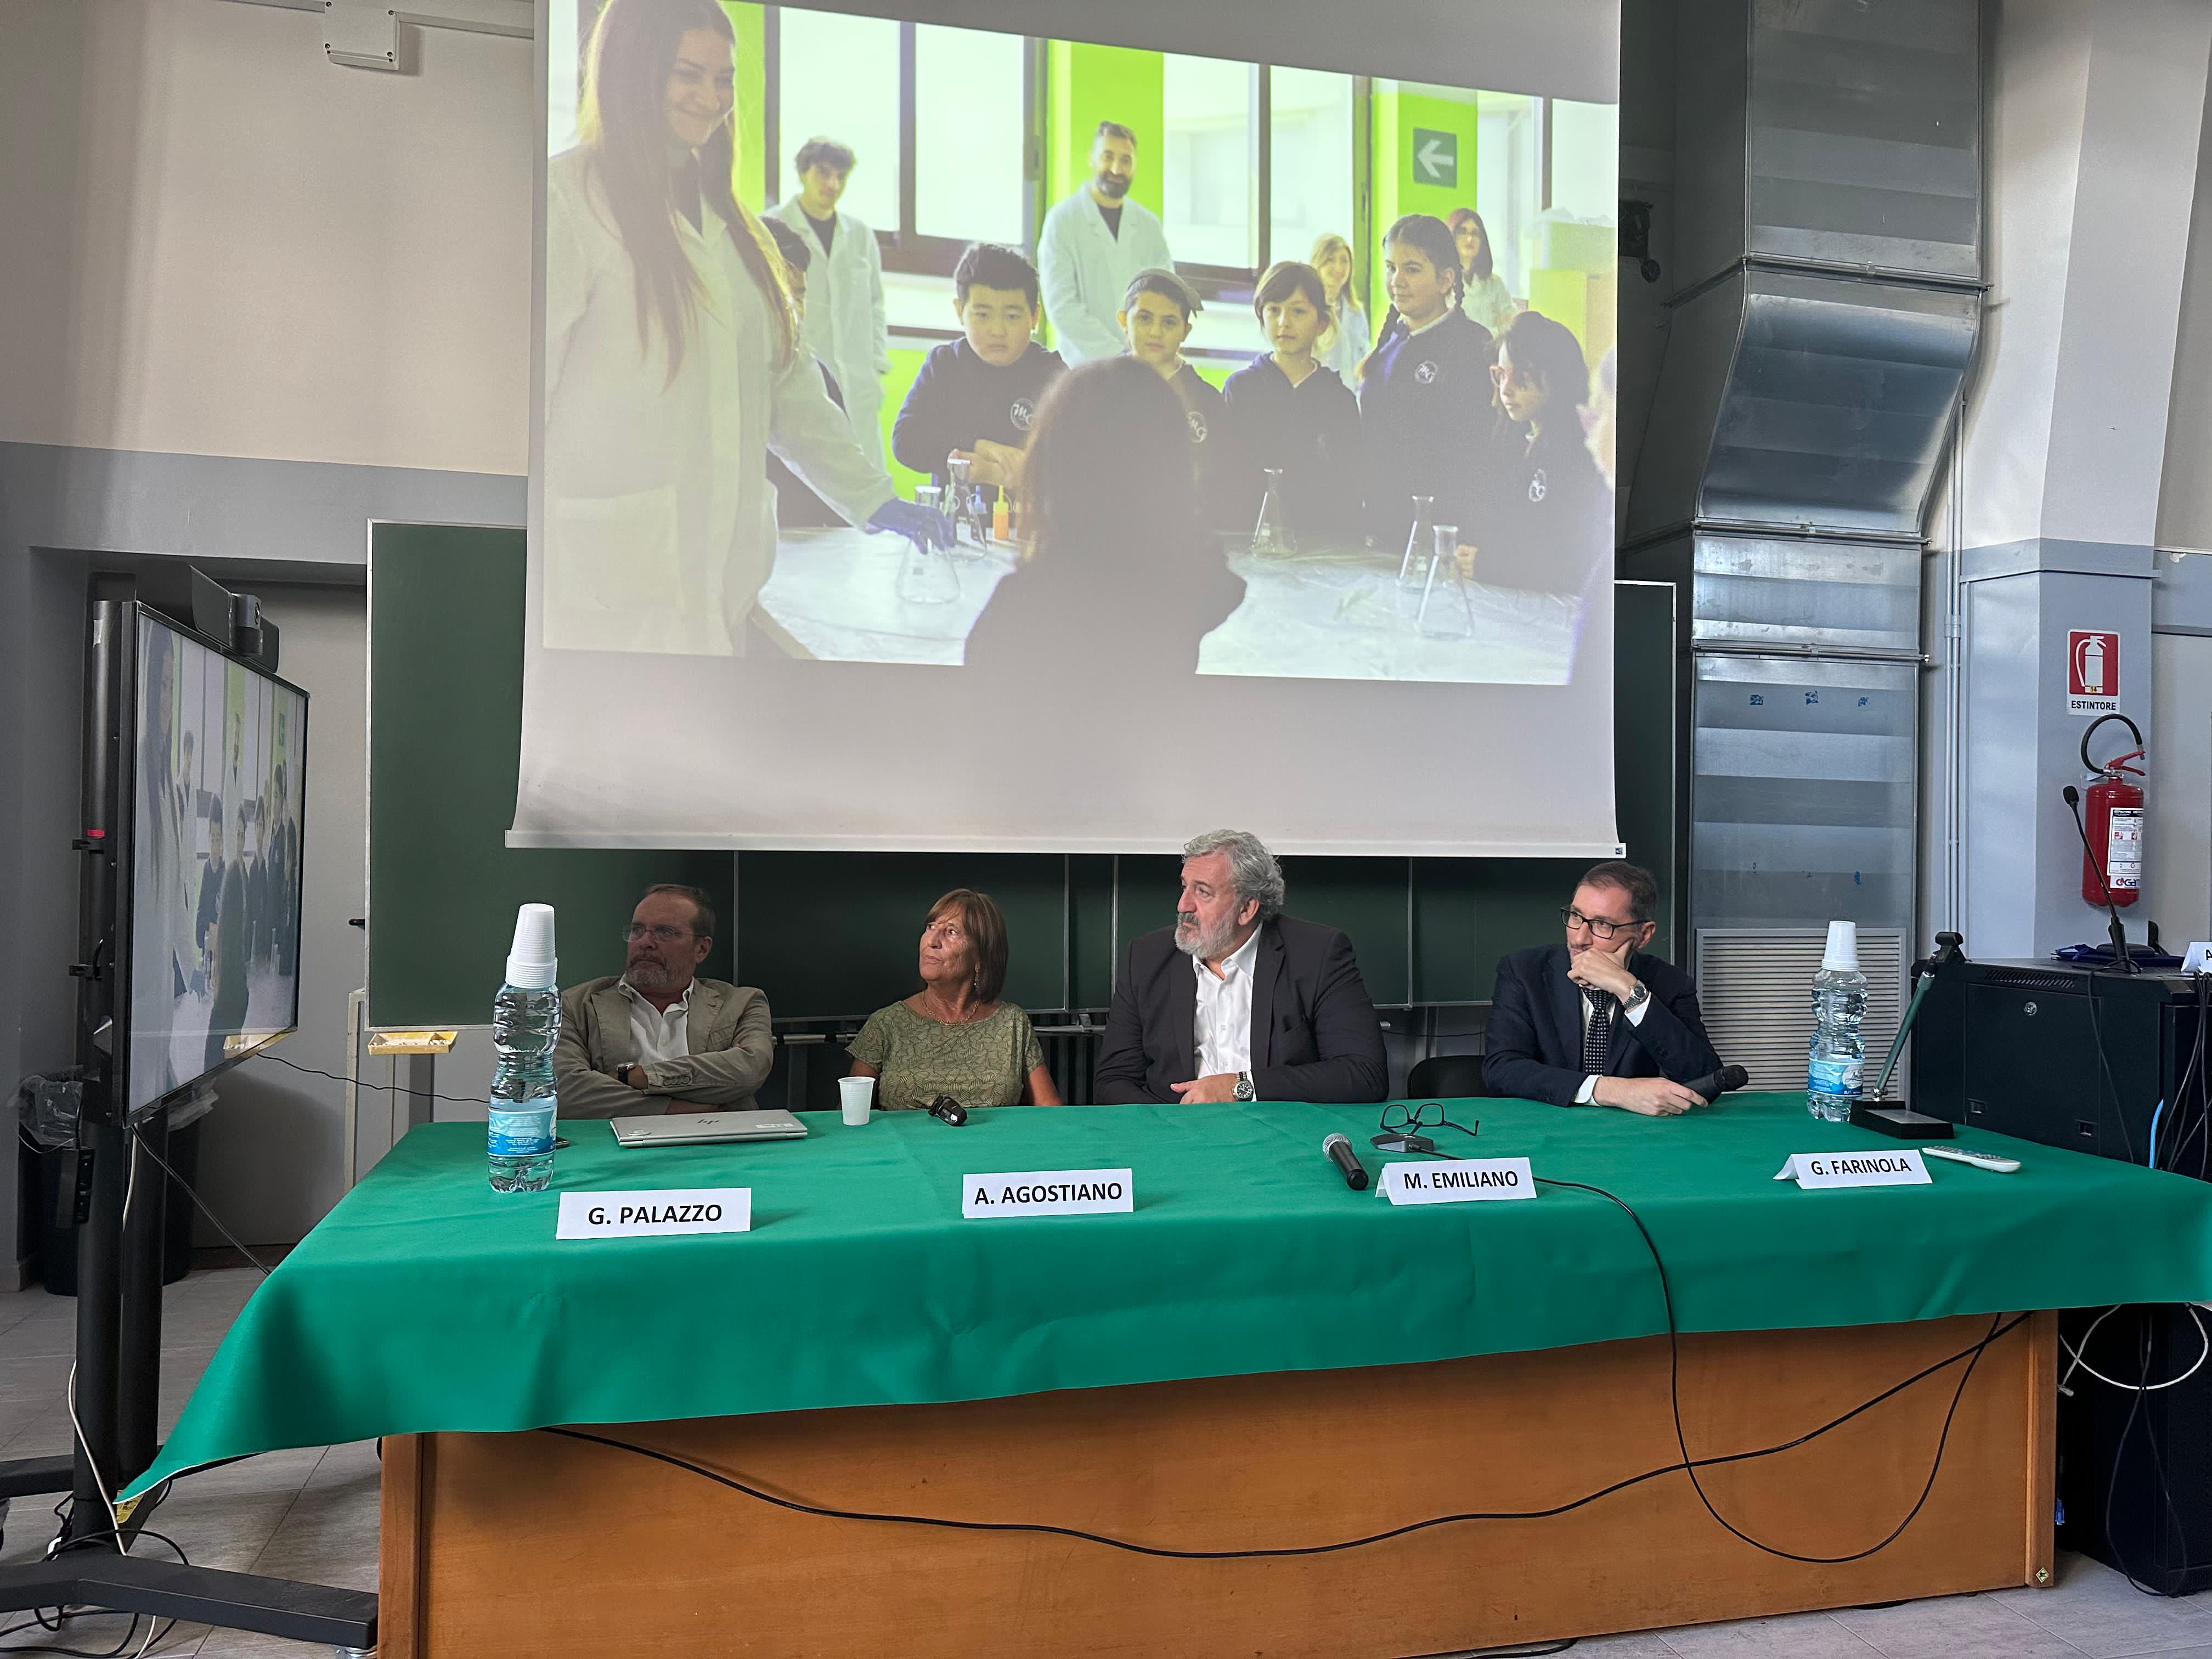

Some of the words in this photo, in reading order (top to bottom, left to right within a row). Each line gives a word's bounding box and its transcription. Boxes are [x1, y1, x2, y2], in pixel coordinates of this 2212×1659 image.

[2071, 700, 2116, 710] ESTINTORE
[1811, 1161, 1829, 1175] G.
[1831, 1158, 1912, 1175] FARINOLA
[1404, 1173, 1427, 1189] M.
[1432, 1171, 1519, 1189] EMILIANO
[974, 1188, 995, 1205] A.
[1001, 1183, 1122, 1204] AGOSTIANO
[588, 1207, 611, 1225] G.
[620, 1204, 723, 1224] PALAZZO
